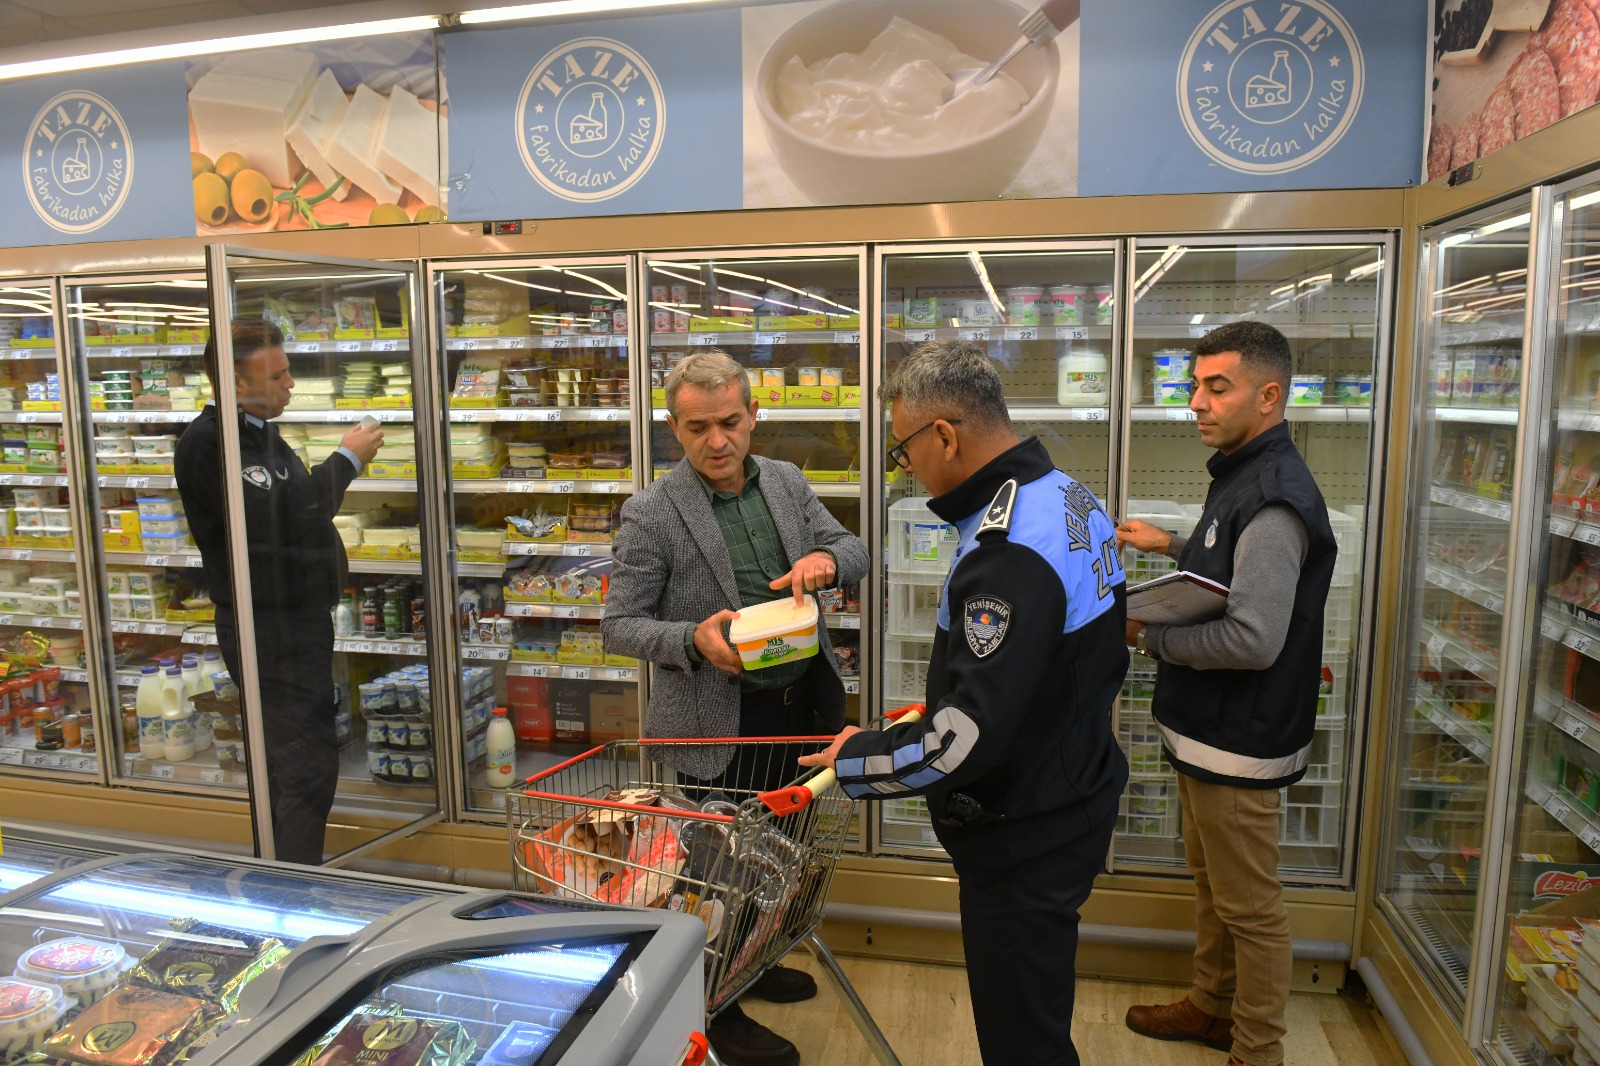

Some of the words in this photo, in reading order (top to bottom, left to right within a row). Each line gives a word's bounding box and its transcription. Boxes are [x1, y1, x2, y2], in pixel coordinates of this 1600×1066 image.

[1206, 2, 1334, 54] TAZE
[537, 50, 640, 98] TAZE
[37, 101, 113, 143] TAZE
[1195, 85, 1301, 158] fabrikadan
[1304, 79, 1346, 141] halka
[529, 124, 616, 188] fabrikadan
[622, 116, 652, 172] halka
[33, 166, 98, 222] fabrikadan
[101, 157, 124, 207] halka
[356, 1050, 390, 1061] MINI
